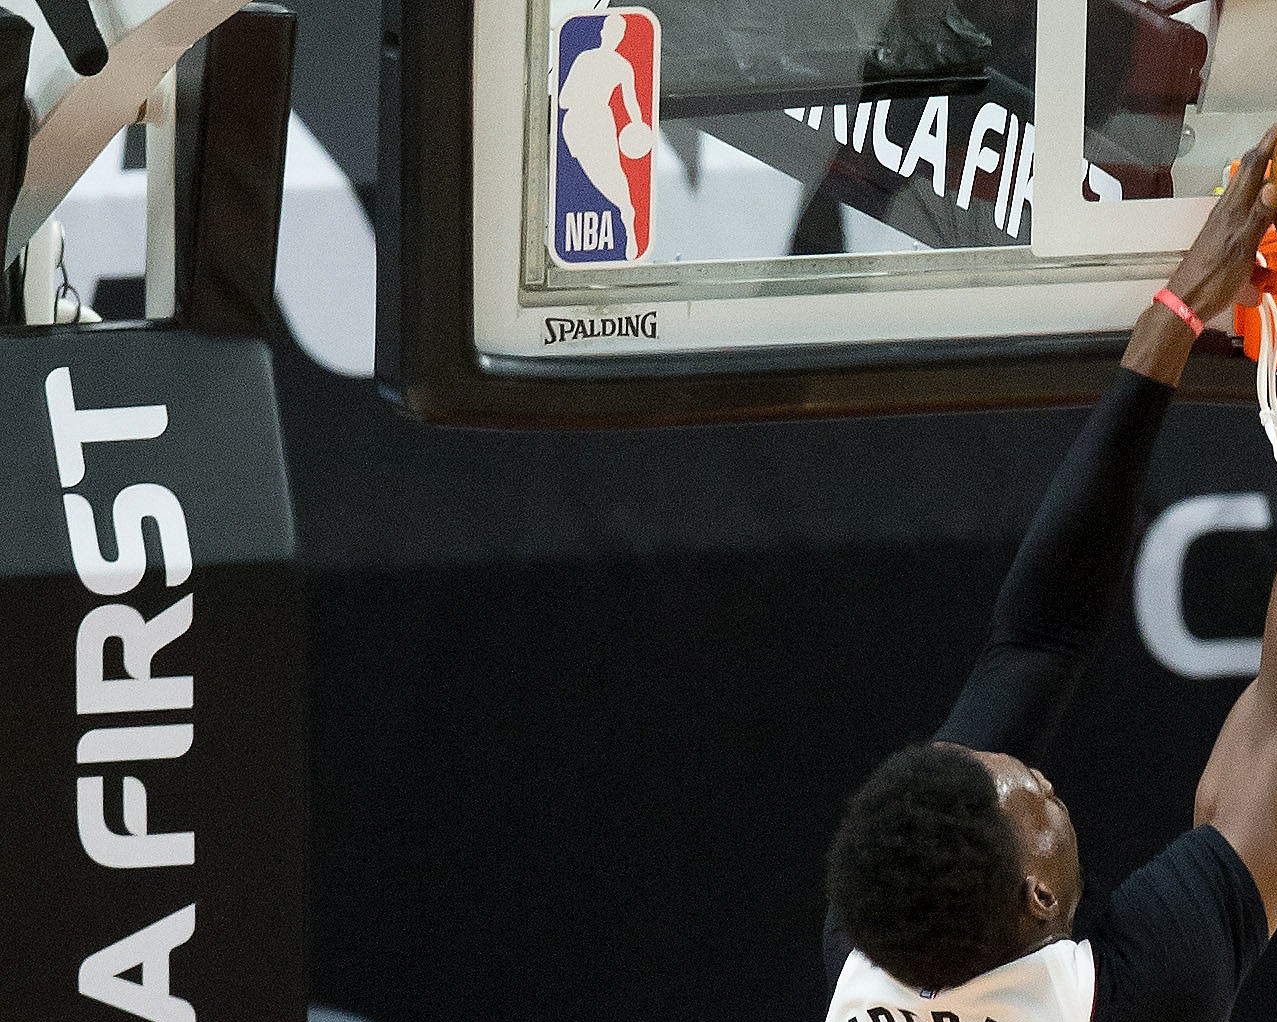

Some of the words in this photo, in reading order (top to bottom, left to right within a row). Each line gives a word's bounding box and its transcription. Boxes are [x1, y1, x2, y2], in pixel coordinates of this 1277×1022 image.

[564, 210, 615, 252] NBA
[544, 311, 658, 345] SPALDING
[45, 366, 196, 870] FIRST
